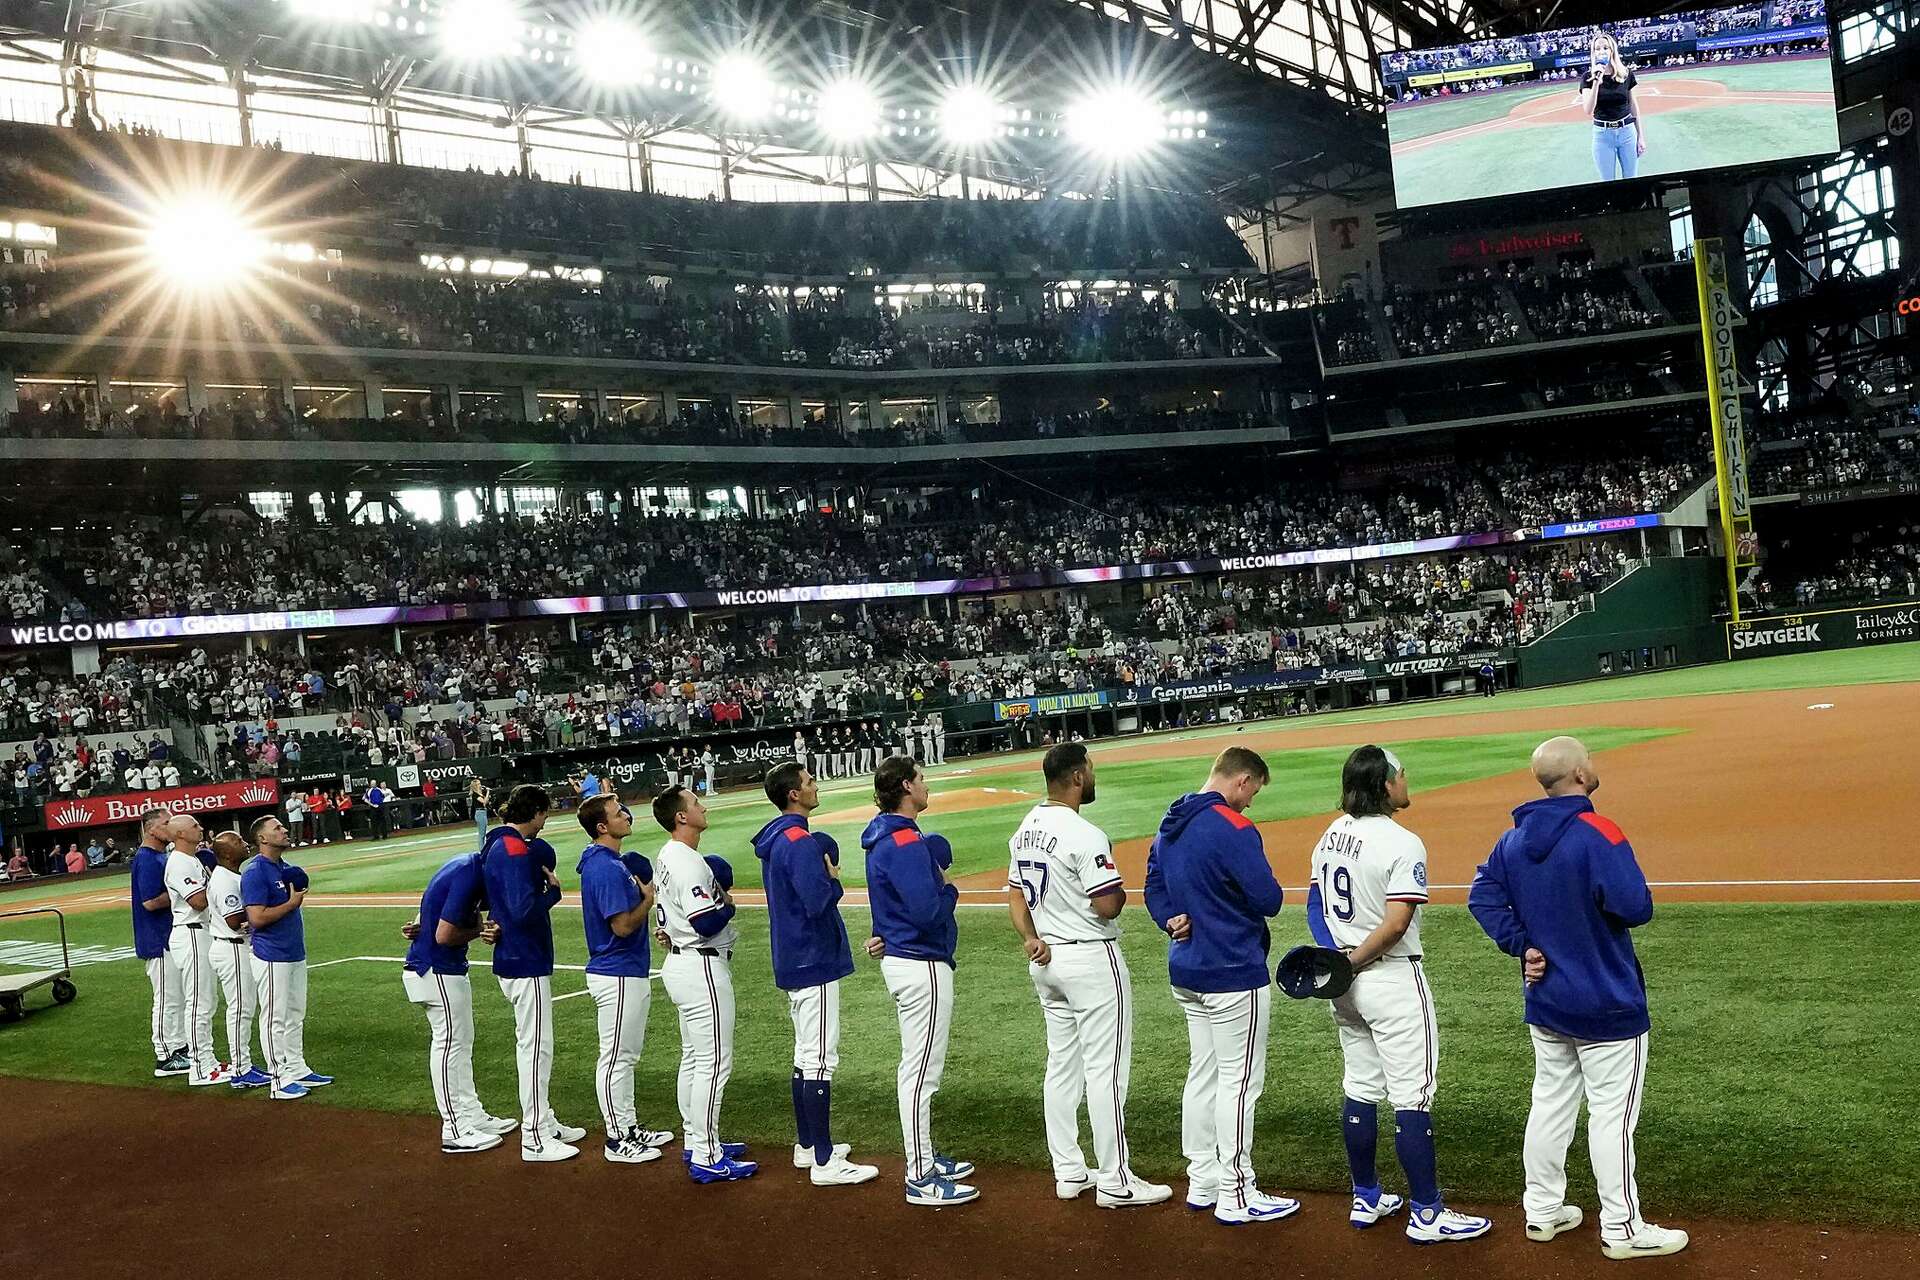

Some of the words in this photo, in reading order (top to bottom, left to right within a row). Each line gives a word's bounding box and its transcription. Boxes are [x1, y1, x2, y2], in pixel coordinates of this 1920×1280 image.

[1889, 113, 1911, 131] 42
[1713, 291, 1731, 363] ROOT
[1721, 373, 1734, 391] 4
[1723, 403, 1746, 512] CHIKIN
[1807, 490, 1841, 503] SHIFT
[1564, 523, 1586, 535] ALL
[1599, 518, 1636, 530] TEXAS
[1220, 554, 1283, 571] WELCOME
[1289, 553, 1305, 565] TO
[717, 588, 787, 606] WELCOME
[791, 587, 810, 602] TO
[887, 582, 915, 596] Field
[11, 620, 127, 645] WELCOME
[136, 619, 167, 638] TO
[182, 614, 245, 634] Globe
[249, 612, 286, 631] Life
[289, 609, 335, 628] Field
[1733, 622, 1752, 631] 329
[1784, 617, 1803, 627] 334
[1732, 622, 1822, 651] SEATGEEK
[1384, 656, 1449, 674] VICTORY
[1151, 679, 1233, 700] Germania
[1038, 696, 1058, 712] HOW
[1072, 693, 1099, 708] NACHO
[423, 764, 474, 780] TOYOTA
[106, 793, 227, 821] Budweiser
[1014, 830, 1058, 854] URVELO
[1017, 859, 1051, 911] 57
[1321, 862, 1356, 924] 19
